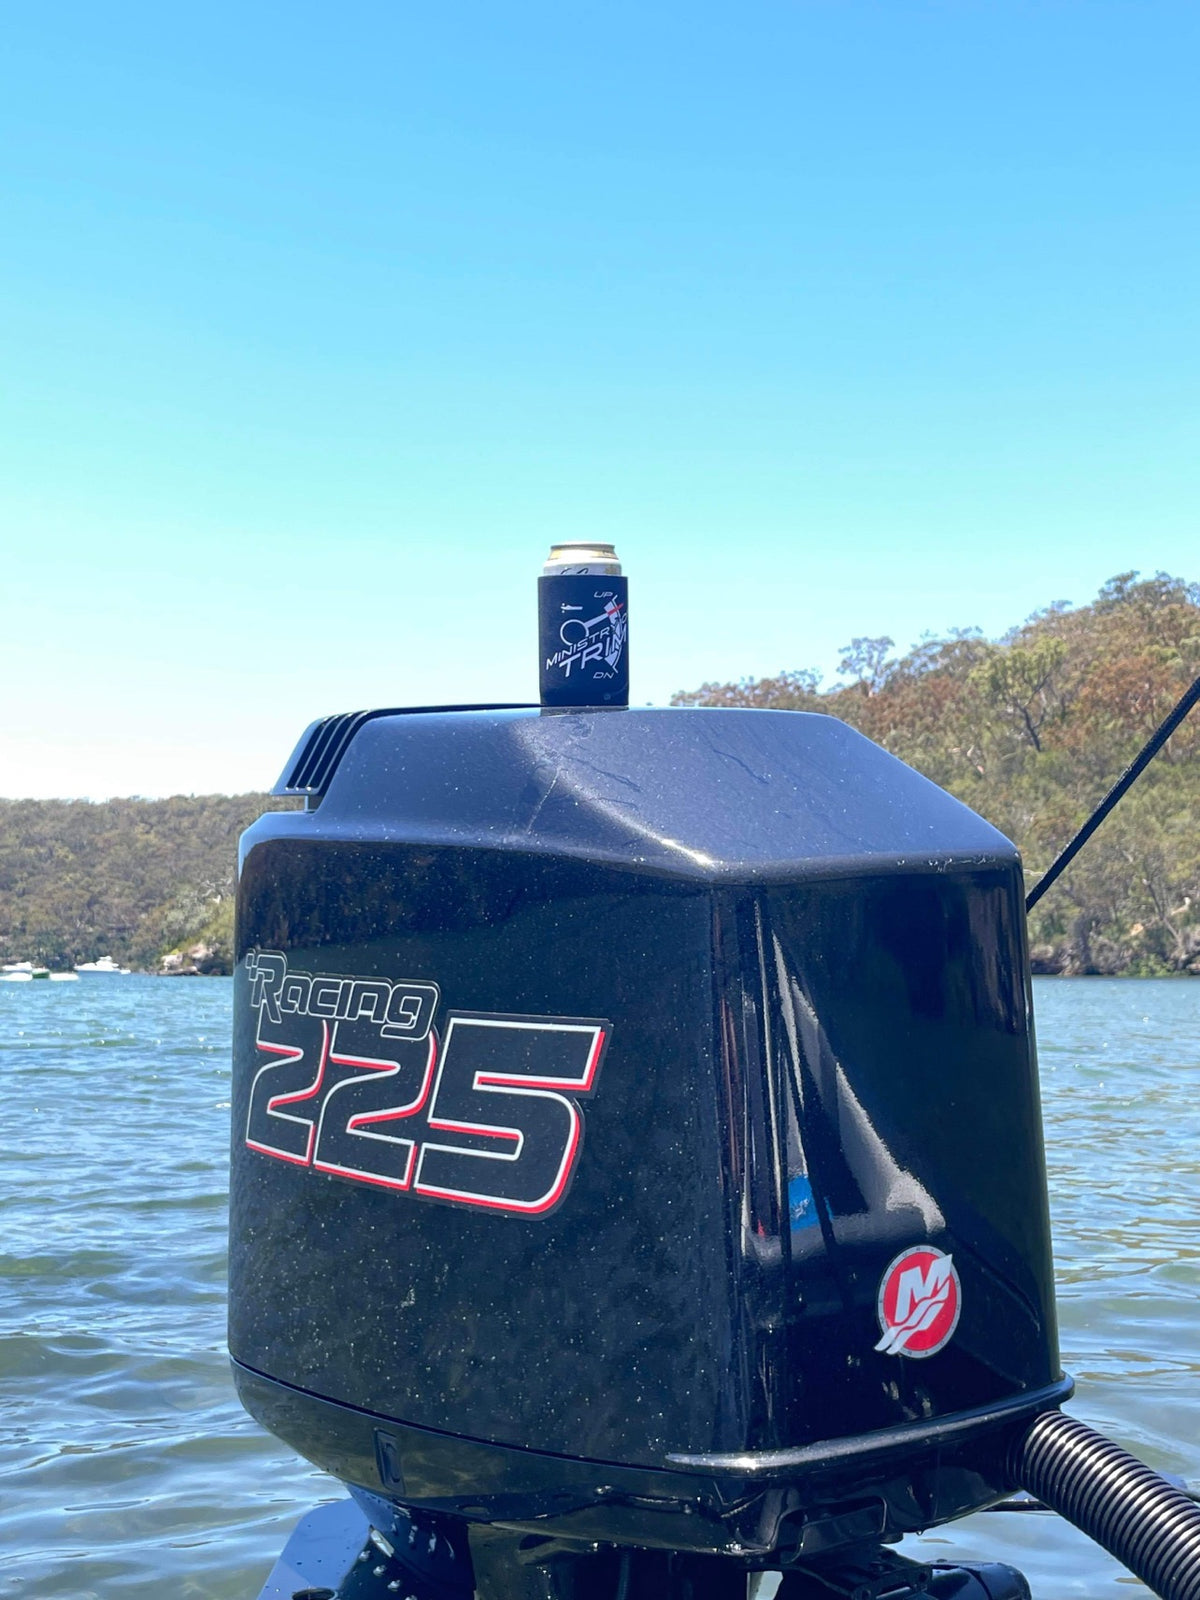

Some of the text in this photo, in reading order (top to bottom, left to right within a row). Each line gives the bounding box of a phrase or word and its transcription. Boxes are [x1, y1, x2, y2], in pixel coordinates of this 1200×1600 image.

[546, 619, 618, 670] MINISTRY
[559, 623, 627, 677] TRIM
[593, 671, 614, 679] DN
[245, 1000, 605, 1214] 225
